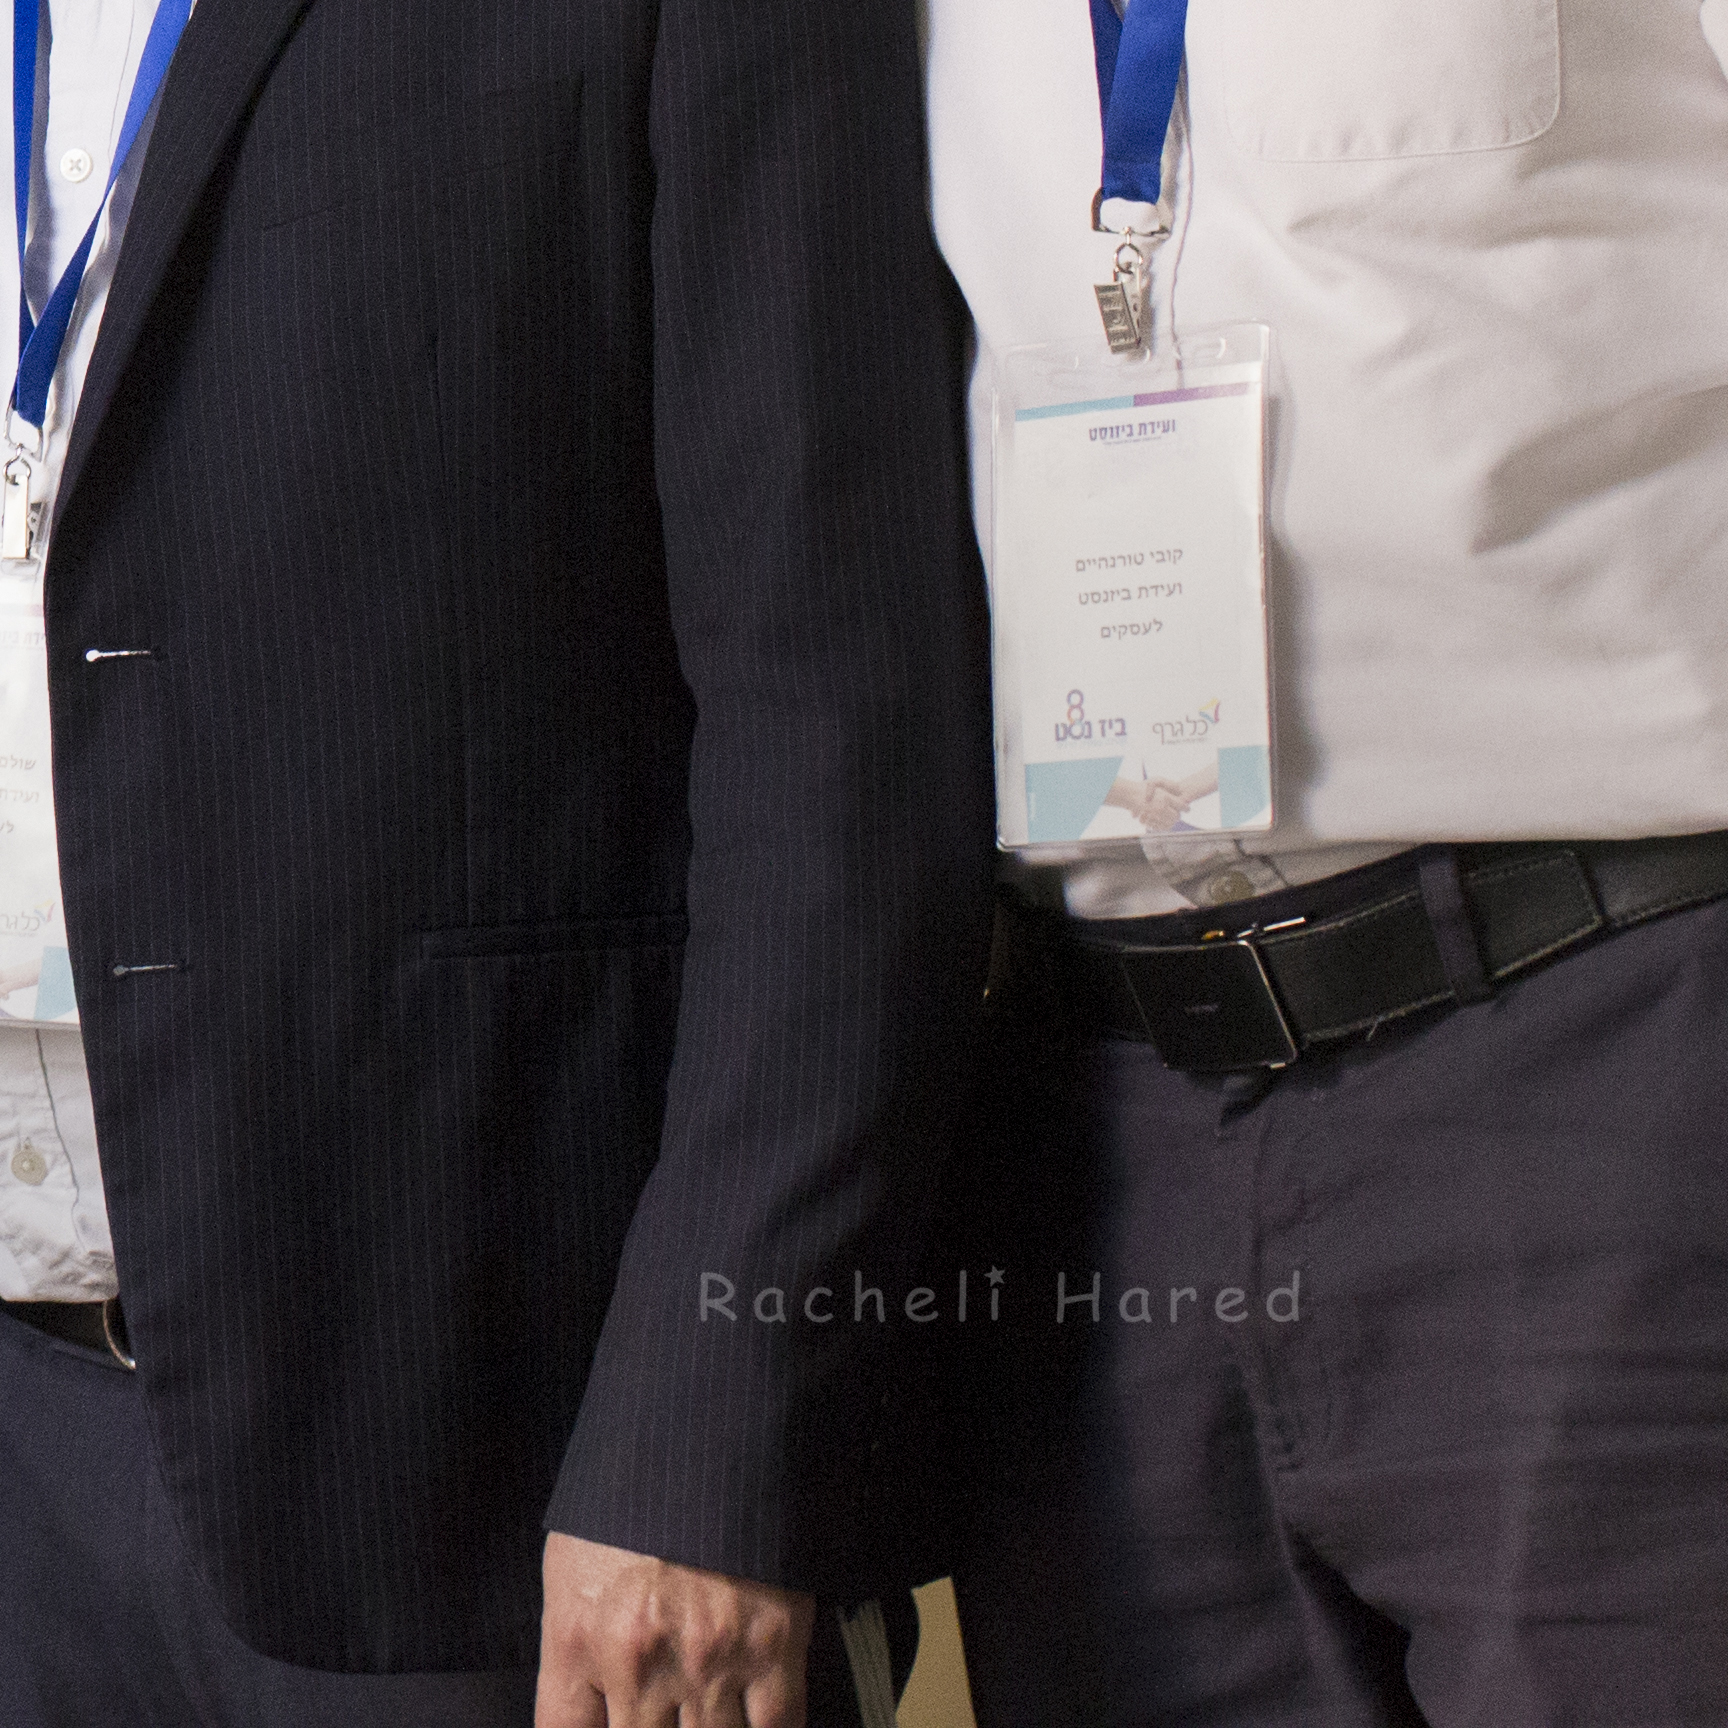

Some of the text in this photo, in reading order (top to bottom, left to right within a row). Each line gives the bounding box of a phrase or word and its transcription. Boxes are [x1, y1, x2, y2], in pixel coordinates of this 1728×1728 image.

[1138, 419, 1176, 436] ועידת
[1149, 548, 1184, 565] קובי
[1078, 582, 1183, 605] ועידת ביזנסט
[1100, 617, 1163, 640] לעסקים
